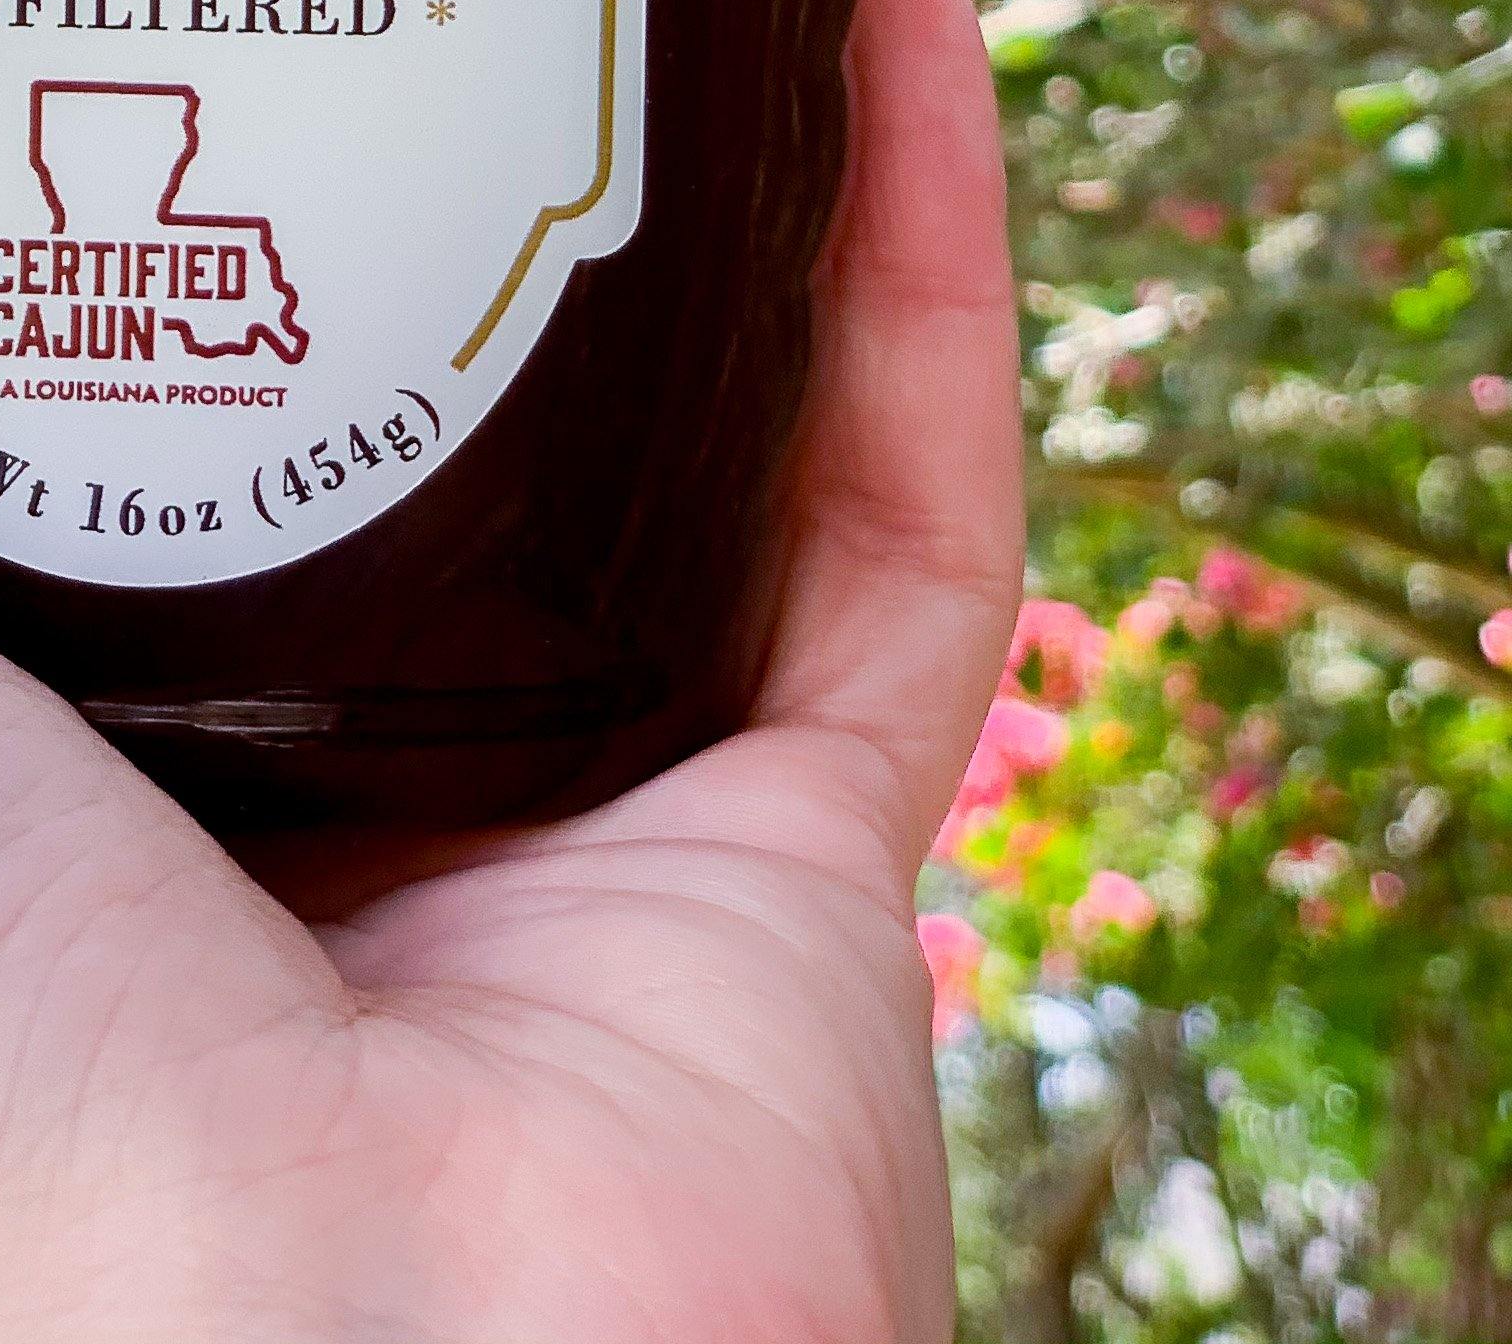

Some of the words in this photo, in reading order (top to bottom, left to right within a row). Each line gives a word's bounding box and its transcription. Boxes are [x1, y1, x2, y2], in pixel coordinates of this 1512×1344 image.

[24, 379, 161, 404] LOUISIANA
[165, 384, 289, 408] PRODUCT
[78, 482, 223, 537] 16oz
[251, 387, 441, 530] (454g)
